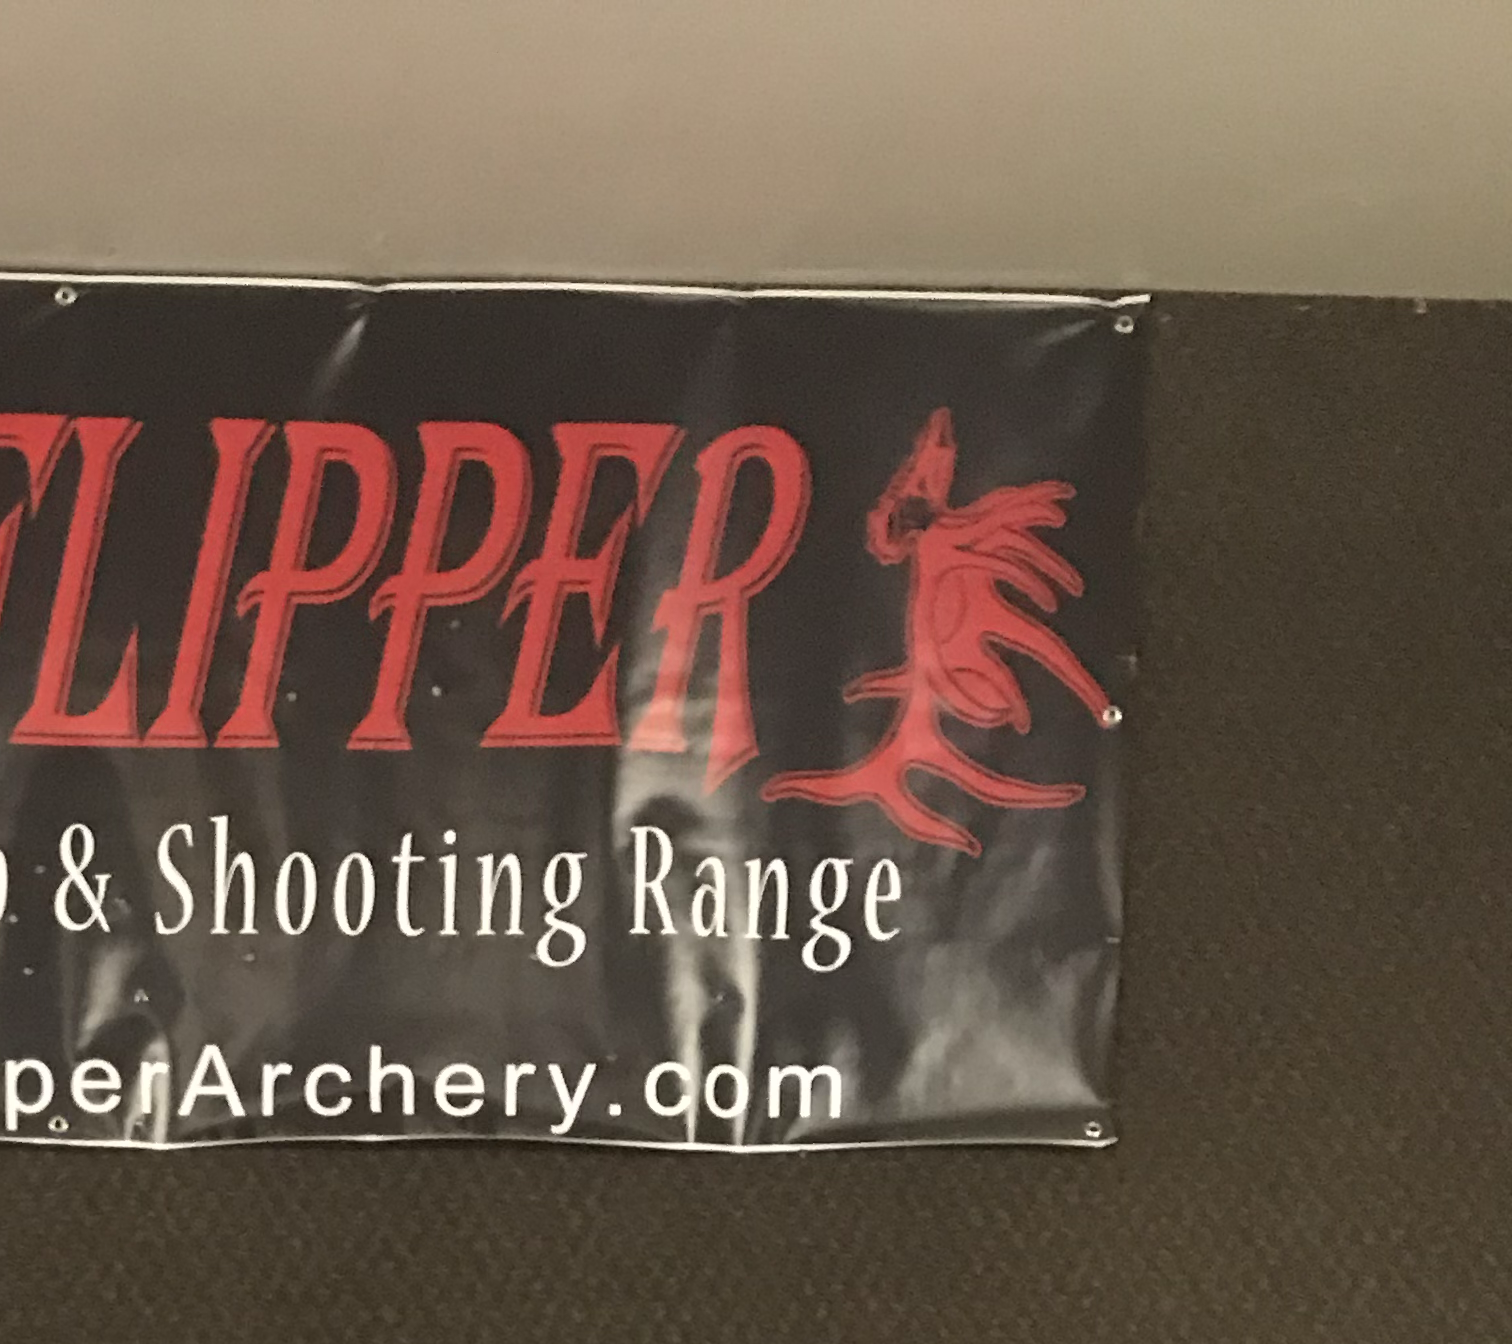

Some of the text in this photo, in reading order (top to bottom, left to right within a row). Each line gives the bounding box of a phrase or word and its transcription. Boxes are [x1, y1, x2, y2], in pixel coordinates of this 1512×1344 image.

[53, 823, 112, 934] &
[154, 815, 588, 967] Shooting
[629, 824, 904, 972] Range
